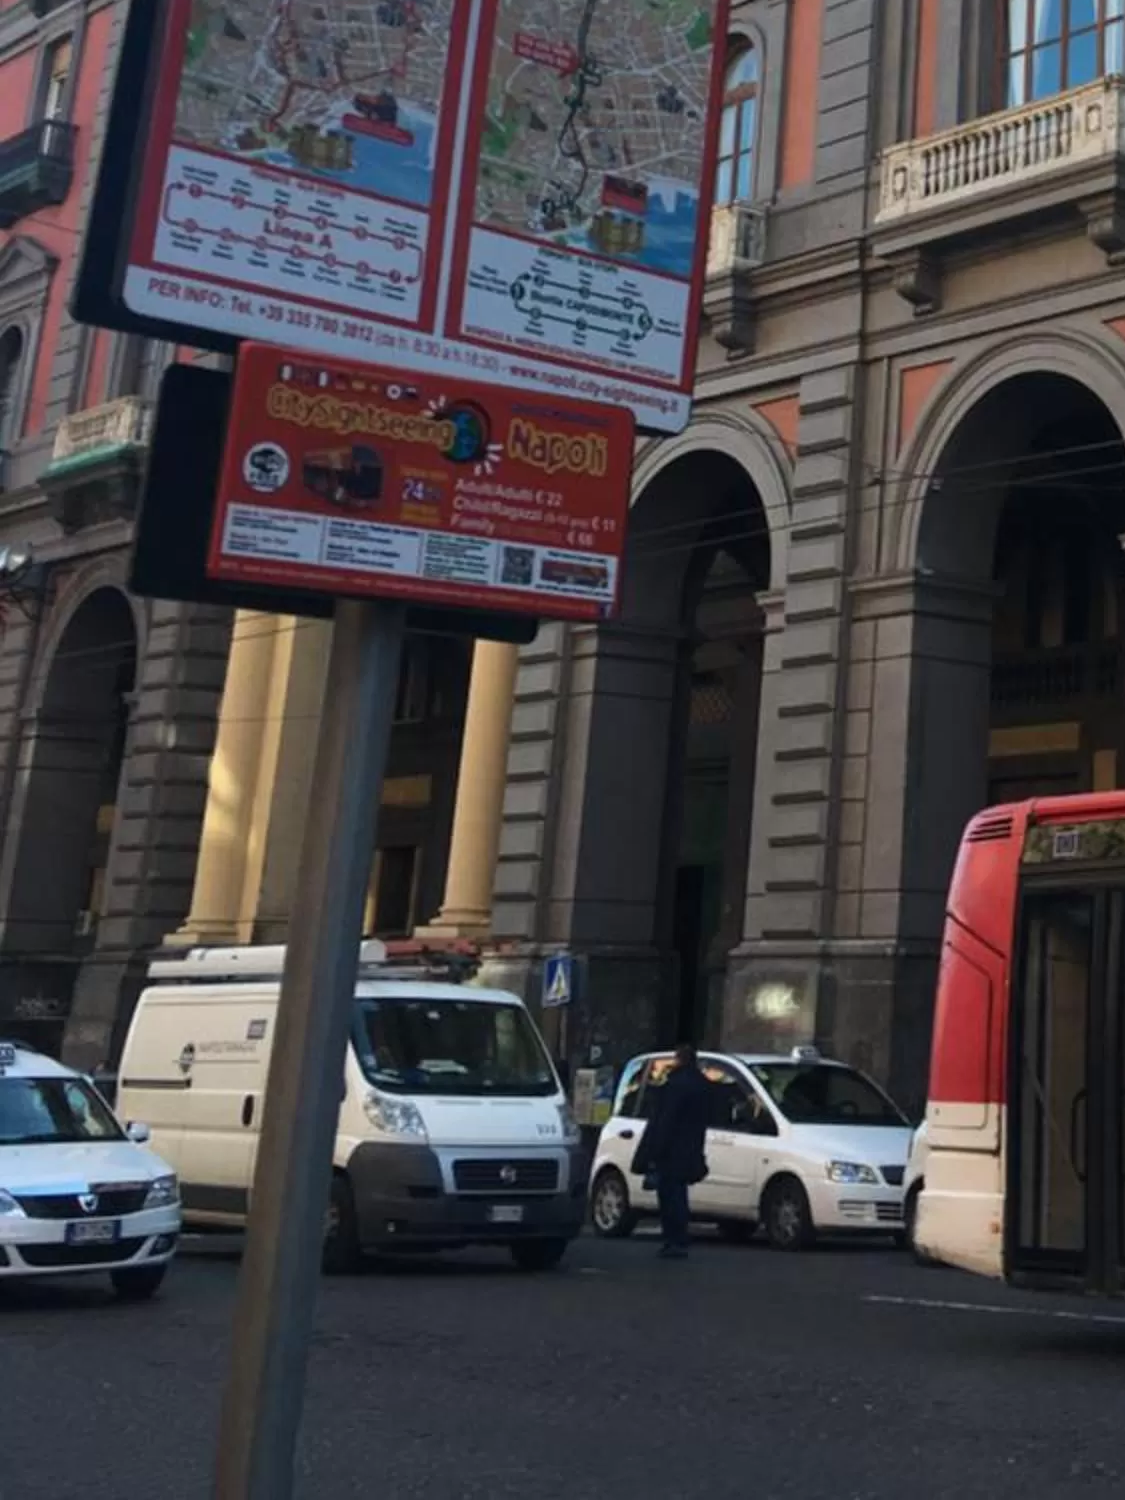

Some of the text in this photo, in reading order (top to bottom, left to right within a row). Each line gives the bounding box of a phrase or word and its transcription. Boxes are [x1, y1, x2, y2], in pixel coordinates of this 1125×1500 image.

[262, 219, 333, 250] Linea A
[147, 277, 182, 299] PER
[508, 417, 609, 477] Napoli
